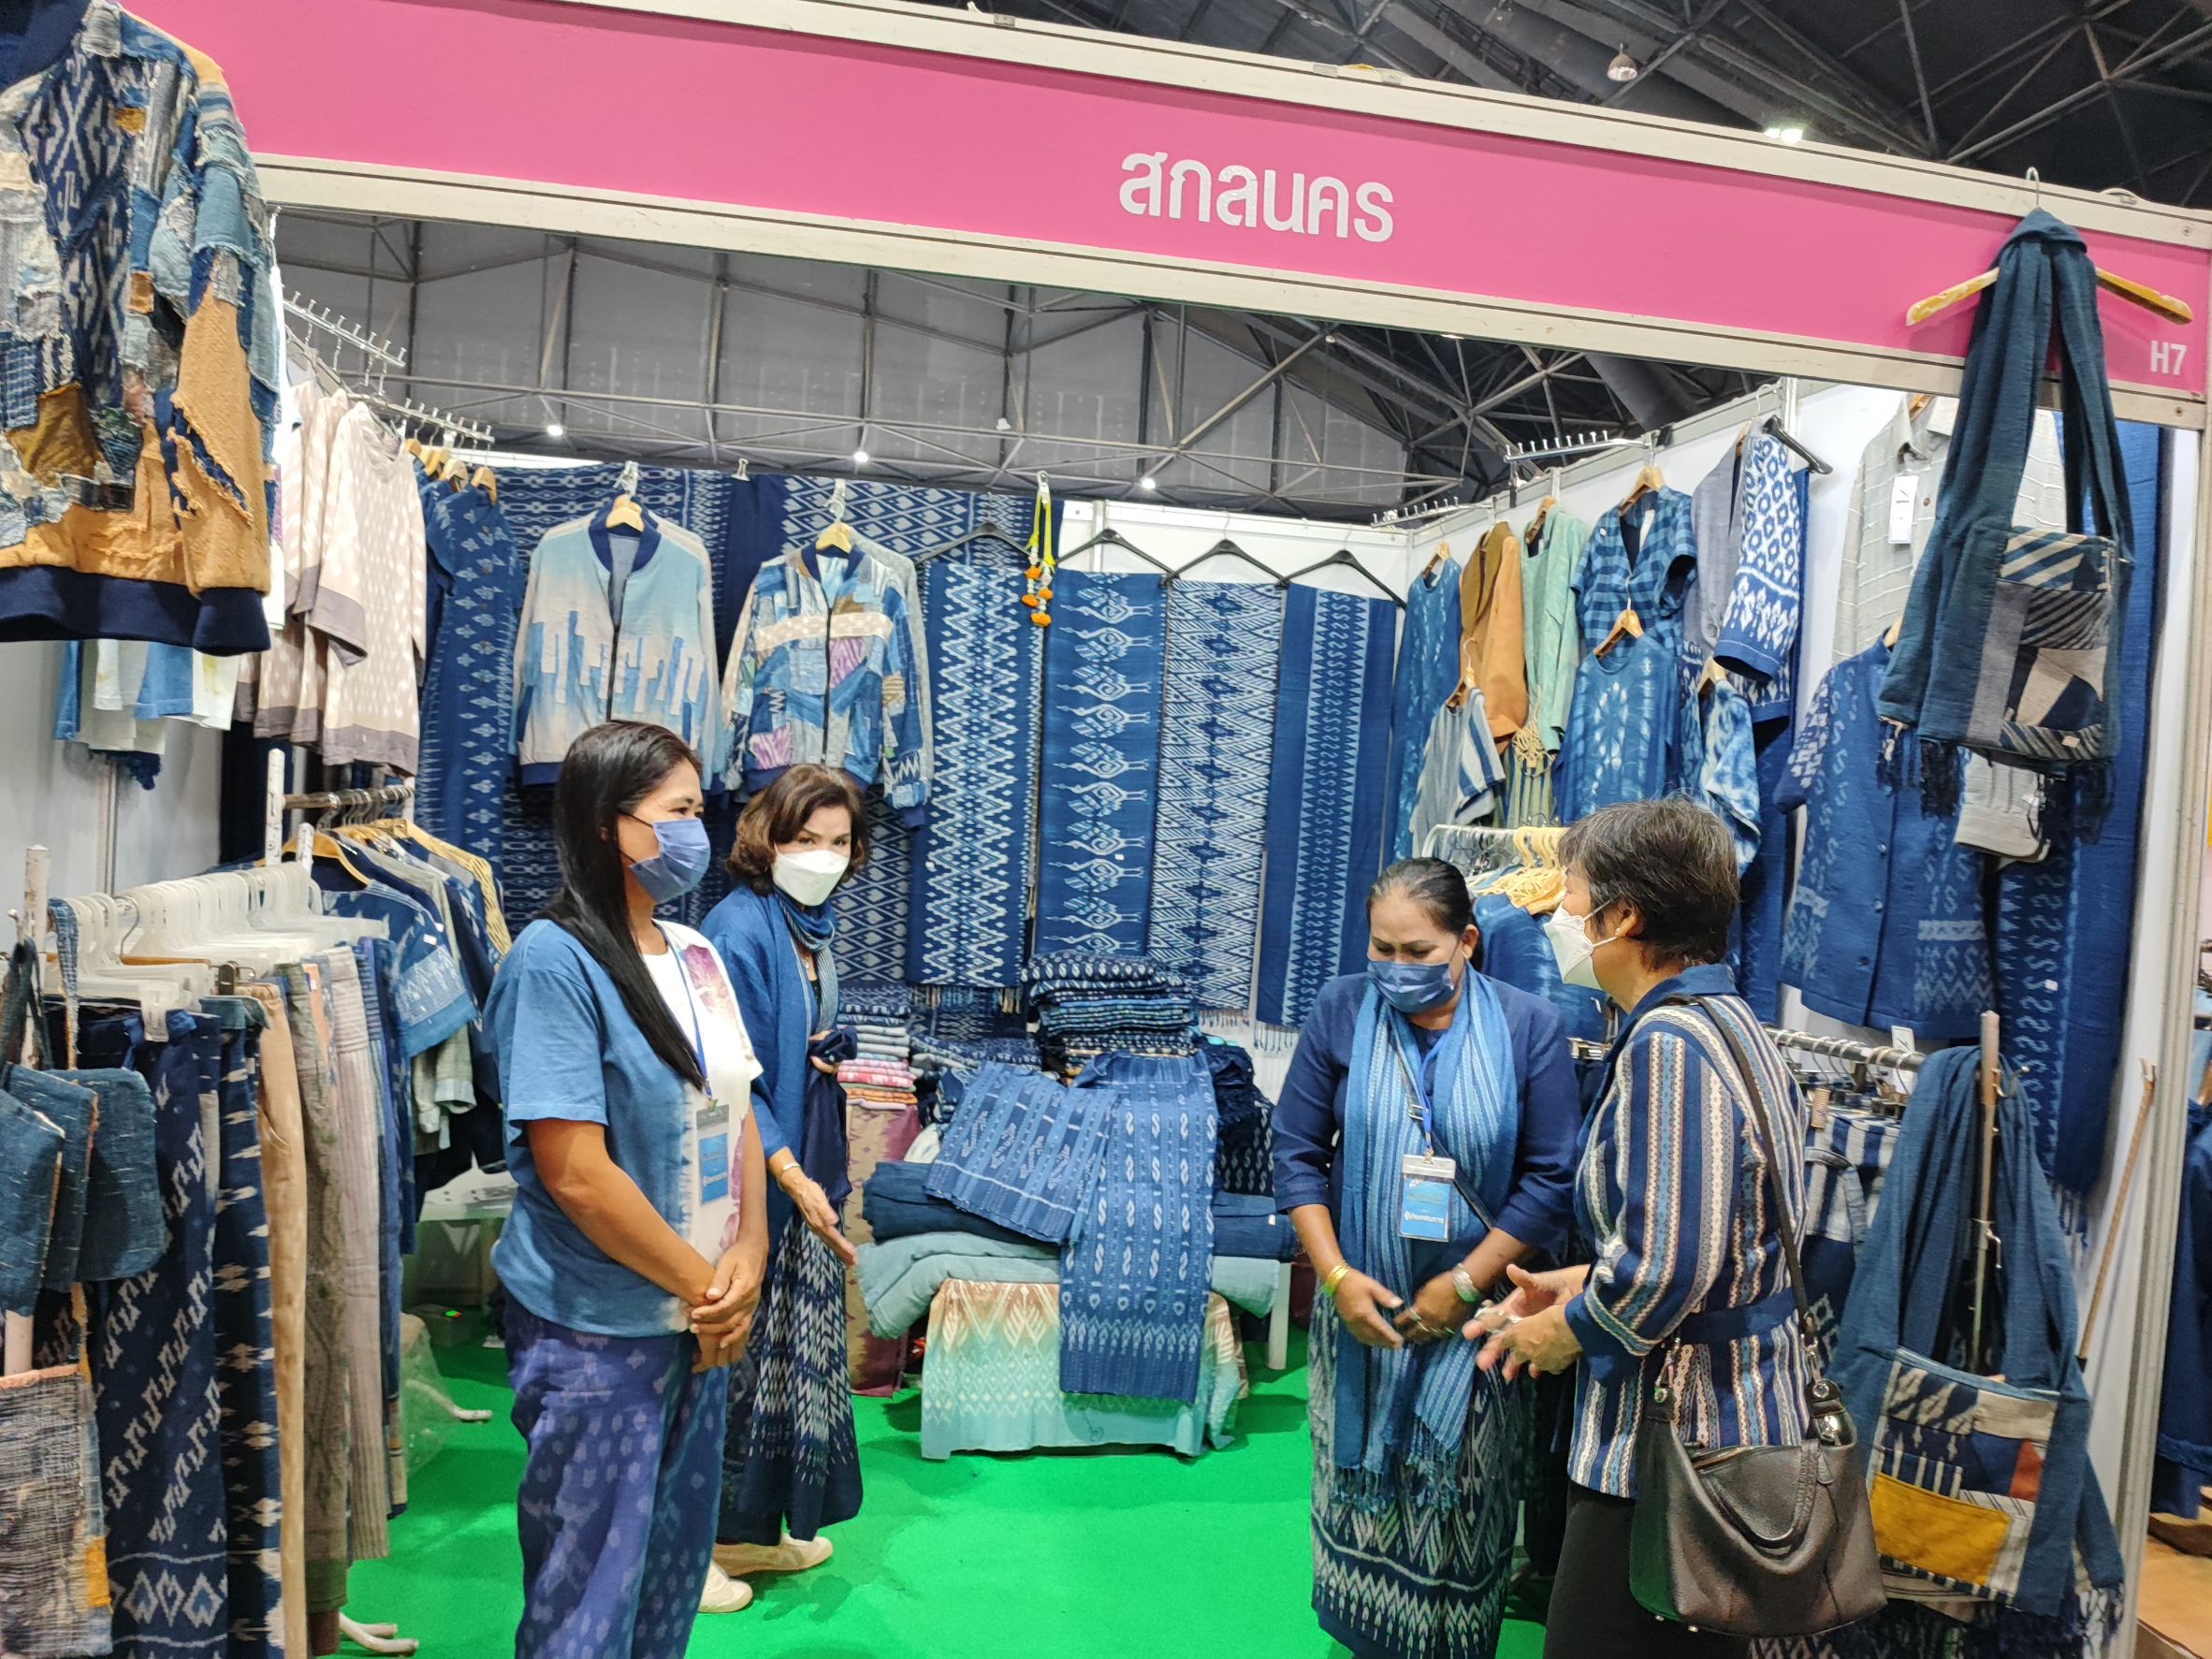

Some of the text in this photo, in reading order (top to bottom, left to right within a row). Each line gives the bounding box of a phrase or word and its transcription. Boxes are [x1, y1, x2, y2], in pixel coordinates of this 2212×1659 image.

[1119, 151, 1394, 243] สกลนคร
[2150, 340, 2188, 375] H7
